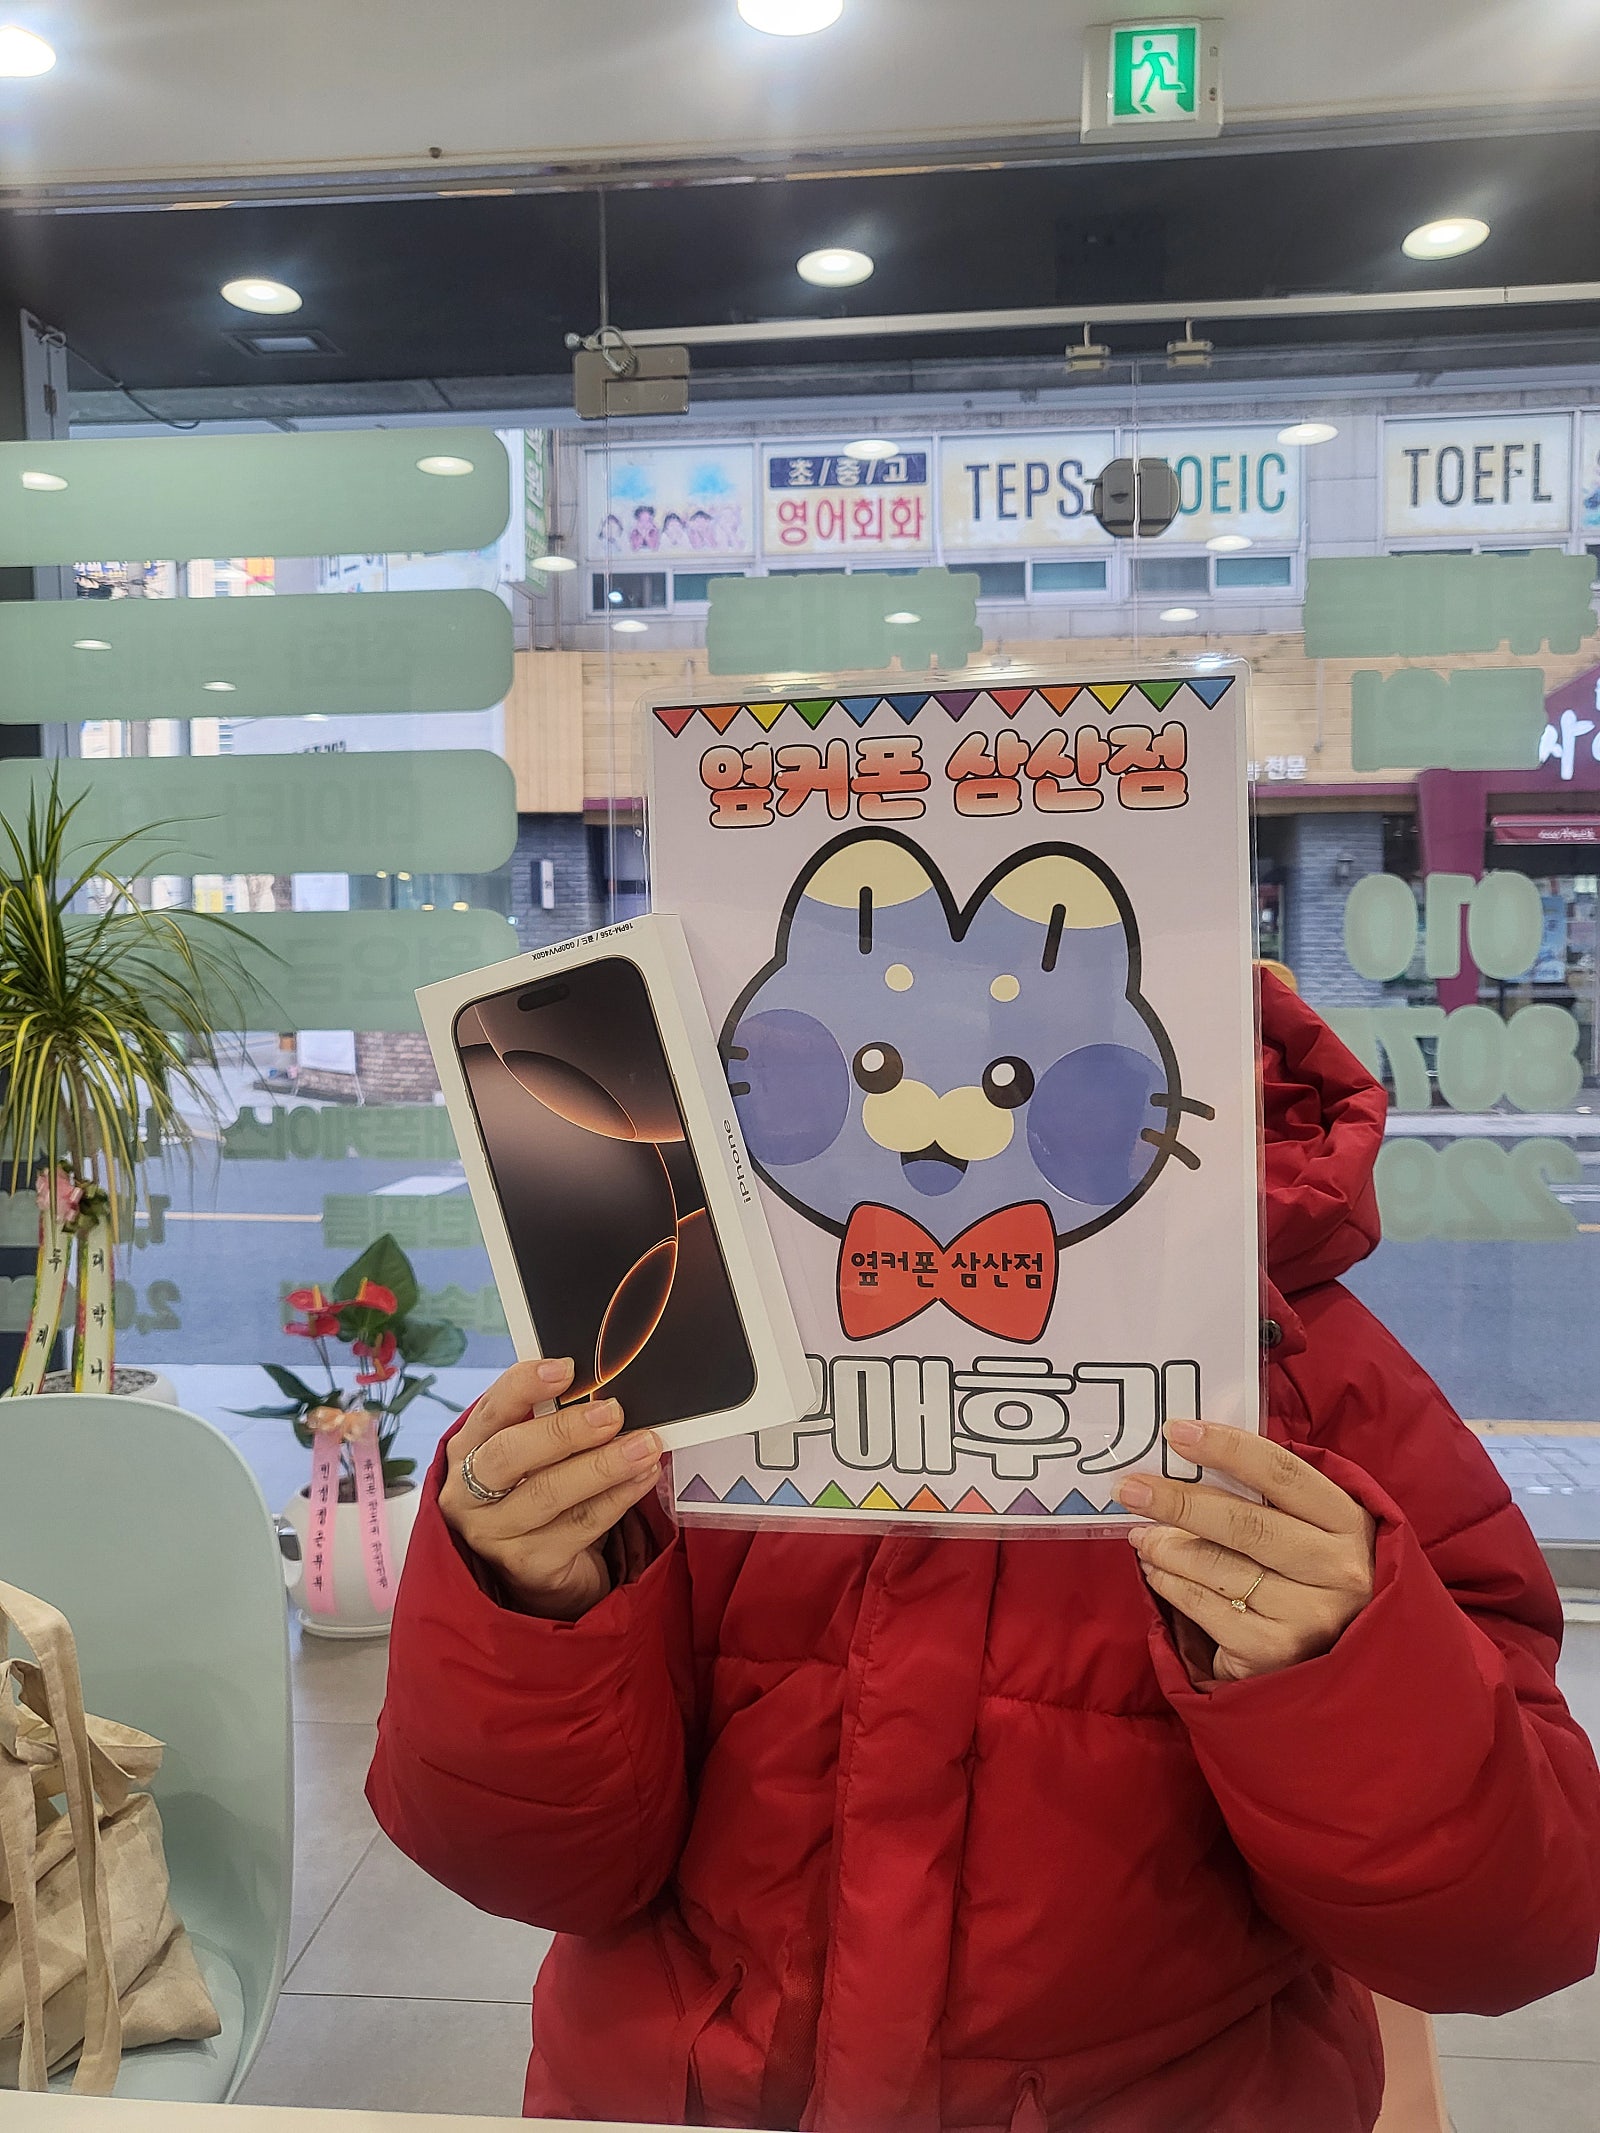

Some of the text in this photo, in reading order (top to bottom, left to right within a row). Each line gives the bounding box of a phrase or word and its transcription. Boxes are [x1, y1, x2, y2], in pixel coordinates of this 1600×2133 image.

[785, 455, 910, 488] 초/중/고
[964, 458, 1084, 523] TEPS
[1162, 452, 1286, 515] OEIC
[1402, 443, 1553, 509] TOEFL
[776, 495, 925, 547] 영어회화
[1539, 678, 1600, 781] 사
[698, 721, 1191, 830] 옆커폰 삼산점
[723, 1118, 751, 1204] iPhone
[850, 1248, 1045, 1291] 옆커폰 삼산점
